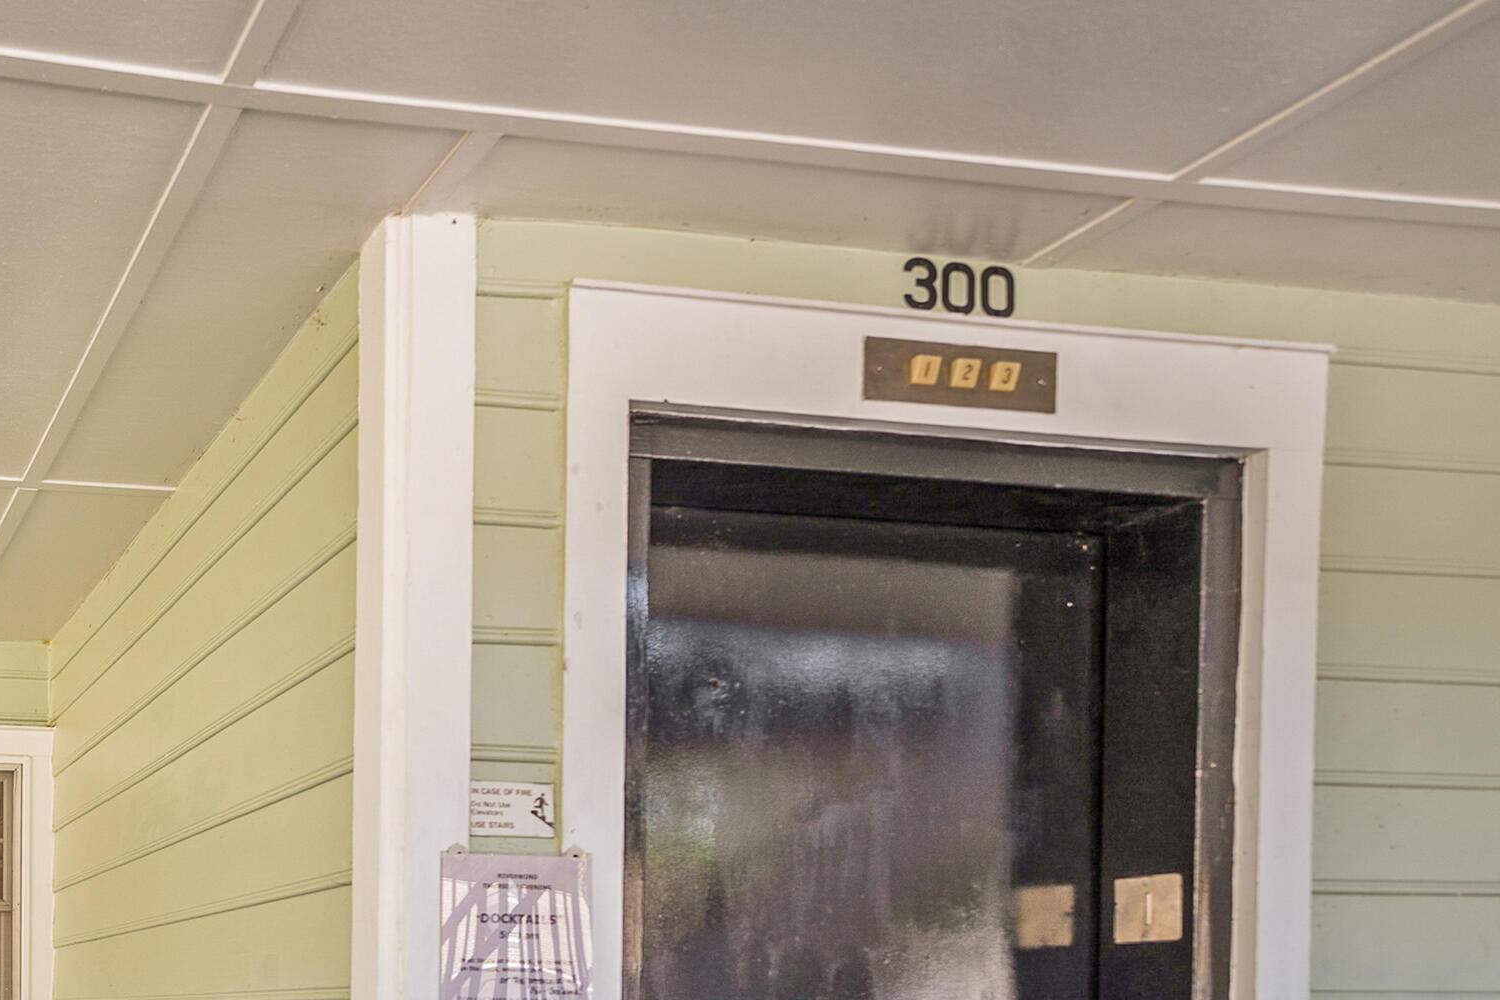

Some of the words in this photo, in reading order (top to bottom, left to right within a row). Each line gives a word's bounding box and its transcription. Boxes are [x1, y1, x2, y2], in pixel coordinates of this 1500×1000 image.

[903, 257, 1015, 318] 300
[923, 361, 932, 378] 1
[962, 364, 974, 381] 2
[1002, 367, 1014, 384] 3
[481, 787, 501, 796] CASE
[503, 788, 513, 796] OF
[515, 788, 532, 797] FIRE
[489, 821, 515, 829] STAIRS
